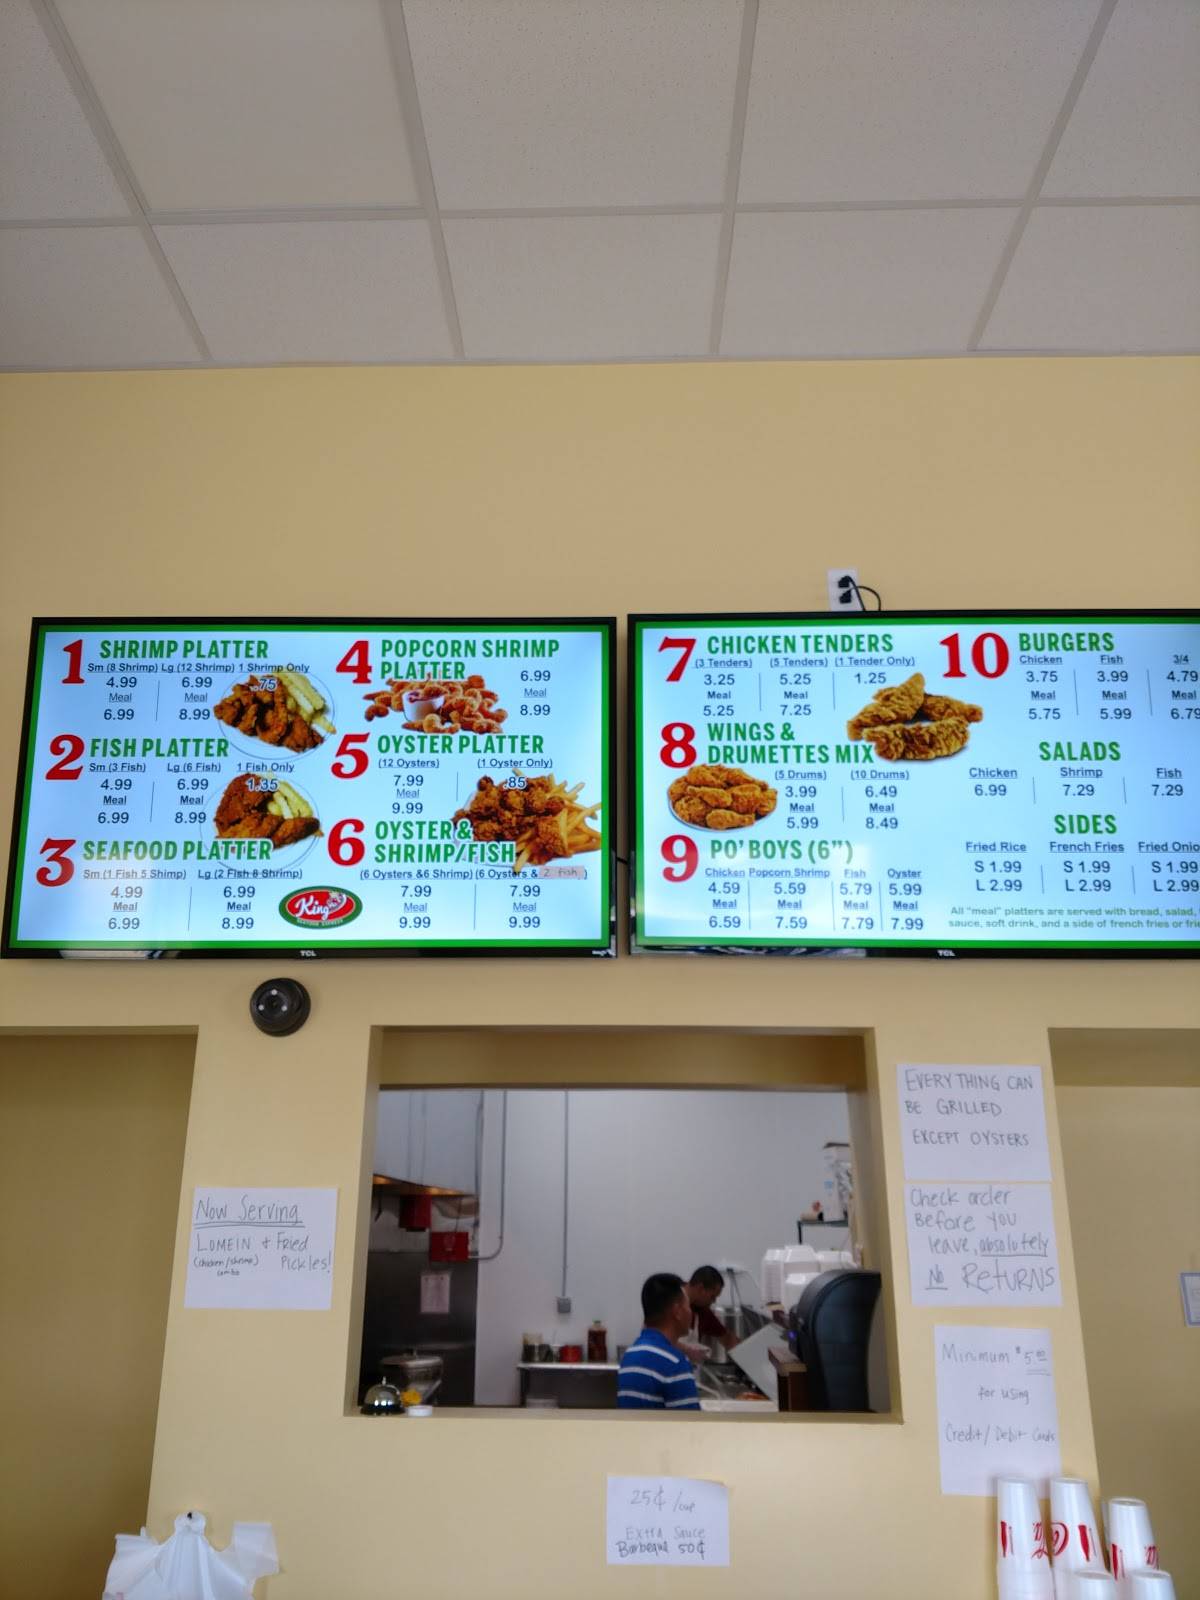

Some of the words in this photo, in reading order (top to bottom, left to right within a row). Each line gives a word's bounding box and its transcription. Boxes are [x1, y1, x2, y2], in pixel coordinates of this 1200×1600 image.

[381, 639, 476, 658] POPCORN
[482, 639, 559, 657] SHRIMP
[708, 636, 798, 654] CHICKEN
[802, 634, 893, 653] TENDERS
[1019, 633, 1114, 652] BURGERS
[100, 640, 178, 659] SHRIMP
[183, 640, 269, 659] PLATTER
[939, 632, 1009, 679] 10
[62, 639, 85, 684] 1
[336, 640, 372, 684] 4
[658, 637, 697, 682] 7
[770, 658, 780, 667] (5
[782, 658, 828, 667] Tenders)
[1020, 655, 1062, 664] Chicken
[1101, 655, 1123, 664] Fish
[1173, 655, 1189, 664] 3/4
[88, 664, 104, 672] Sm
[107, 663, 117, 673] (8
[119, 663, 158, 673] Shrimp)
[161, 664, 174, 674] Lg
[178, 663, 193, 673] (12
[195, 663, 235, 673] Shrimp)
[381, 661, 465, 679] PLATTER
[520, 670, 551, 682] 6.99
[704, 674, 735, 685] 3.25
[780, 673, 811, 685] 5.25
[855, 672, 886, 684] 1.25
[1026, 671, 1058, 683] 3.75
[1097, 671, 1129, 683] 3.99
[1166, 671, 1199, 683] 4.79
[106, 677, 137, 689] 4.99
[182, 676, 212, 689] 6.99
[109, 693, 132, 702] Meal
[524, 688, 546, 697] Meal
[1031, 690, 1055, 700] Meal
[103, 708, 134, 721] 6.99
[179, 708, 211, 721] 8.99
[520, 704, 551, 716] 8.99
[703, 705, 734, 717] 5.25
[780, 705, 811, 716] 7.25
[1029, 708, 1061, 720] 5.75
[1100, 708, 1131, 720] 5.99
[708, 723, 775, 741] WINGS
[780, 722, 795, 741] &
[90, 738, 136, 758] FISH
[142, 738, 229, 758] PLATTER
[377, 735, 454, 754] OYSTER
[459, 735, 544, 754] PLATTER
[659, 722, 697, 768] 8
[45, 734, 85, 780] 2
[331, 733, 370, 779] 5
[708, 745, 830, 764] DRUMETTES
[835, 745, 874, 763] MIX
[1039, 742, 1120, 761] SALADS
[378, 758, 394, 768] (12
[396, 758, 439, 769] Oysters)
[969, 768, 1018, 777] Chicken
[1060, 768, 1102, 778] Shrimp
[1156, 768, 1182, 777] Fish
[101, 779, 132, 790] 4.99
[177, 779, 208, 790] 6.99
[394, 775, 423, 787] 7.99
[785, 786, 817, 798] 3.99
[865, 786, 897, 798] 6.49
[974, 784, 1007, 796] 6.99
[1063, 784, 1095, 796] 7.29
[1152, 785, 1183, 796] 7.29
[180, 795, 203, 804] Meal
[392, 802, 423, 815] 9.99
[790, 803, 815, 812] Meal
[97, 812, 129, 824] 6.99
[174, 811, 206, 824] 8.99
[786, 817, 819, 829] 5.99
[866, 817, 898, 829] 8.49
[375, 821, 451, 839] OYSTER
[457, 821, 471, 839] &
[1054, 815, 1117, 834] SIDES
[328, 818, 366, 866] 6
[966, 842, 997, 852] Fried
[1001, 842, 1026, 852] Rice
[1050, 842, 1091, 852] French
[1095, 842, 1124, 852] Fries
[83, 840, 178, 860] SEAFOOD
[183, 840, 272, 860] PLATTER
[375, 844, 515, 863] SHRIMP/FISH
[749, 840, 802, 859] BOYS
[36, 838, 76, 887] 3
[660, 834, 699, 883] 9
[705, 869, 745, 877] Chicken
[844, 869, 866, 877] Fish
[975, 861, 984, 873] S
[990, 861, 1021, 873] 1.99
[749, 869, 791, 880] Popcorn
[794, 868, 830, 880] Shrimp
[887, 869, 921, 880] Oyster
[400, 886, 431, 897] 7.99
[510, 885, 541, 897] 7.99
[709, 882, 740, 894] 4.59
[774, 883, 806, 895] 5.59
[889, 883, 922, 895] 5.99
[976, 880, 985, 891] L
[990, 879, 1023, 892] 2.99
[110, 886, 143, 898] 4.99
[223, 886, 255, 898] 6.99
[295, 895, 329, 921] King
[513, 903, 536, 912] Meal
[778, 900, 802, 909] Meal
[108, 917, 140, 930] 6.99
[221, 917, 254, 930] 8.99
[399, 917, 431, 929] 9.99
[509, 917, 540, 929] 9.99
[709, 916, 741, 928] 6.59
[776, 917, 808, 929] 7.59
[892, 918, 924, 930] 7.99
[1008, 1076, 1033, 1089] CAN
[905, 1101, 922, 1114] BE
[937, 1098, 1001, 1116] GRILLED
[913, 1129, 959, 1144] EXCEPT
[971, 1131, 1029, 1146] OYSTERS
[911, 1188, 960, 1207] Check
[196, 1197, 227, 1220] Now
[240, 1194, 298, 1225] Serving
